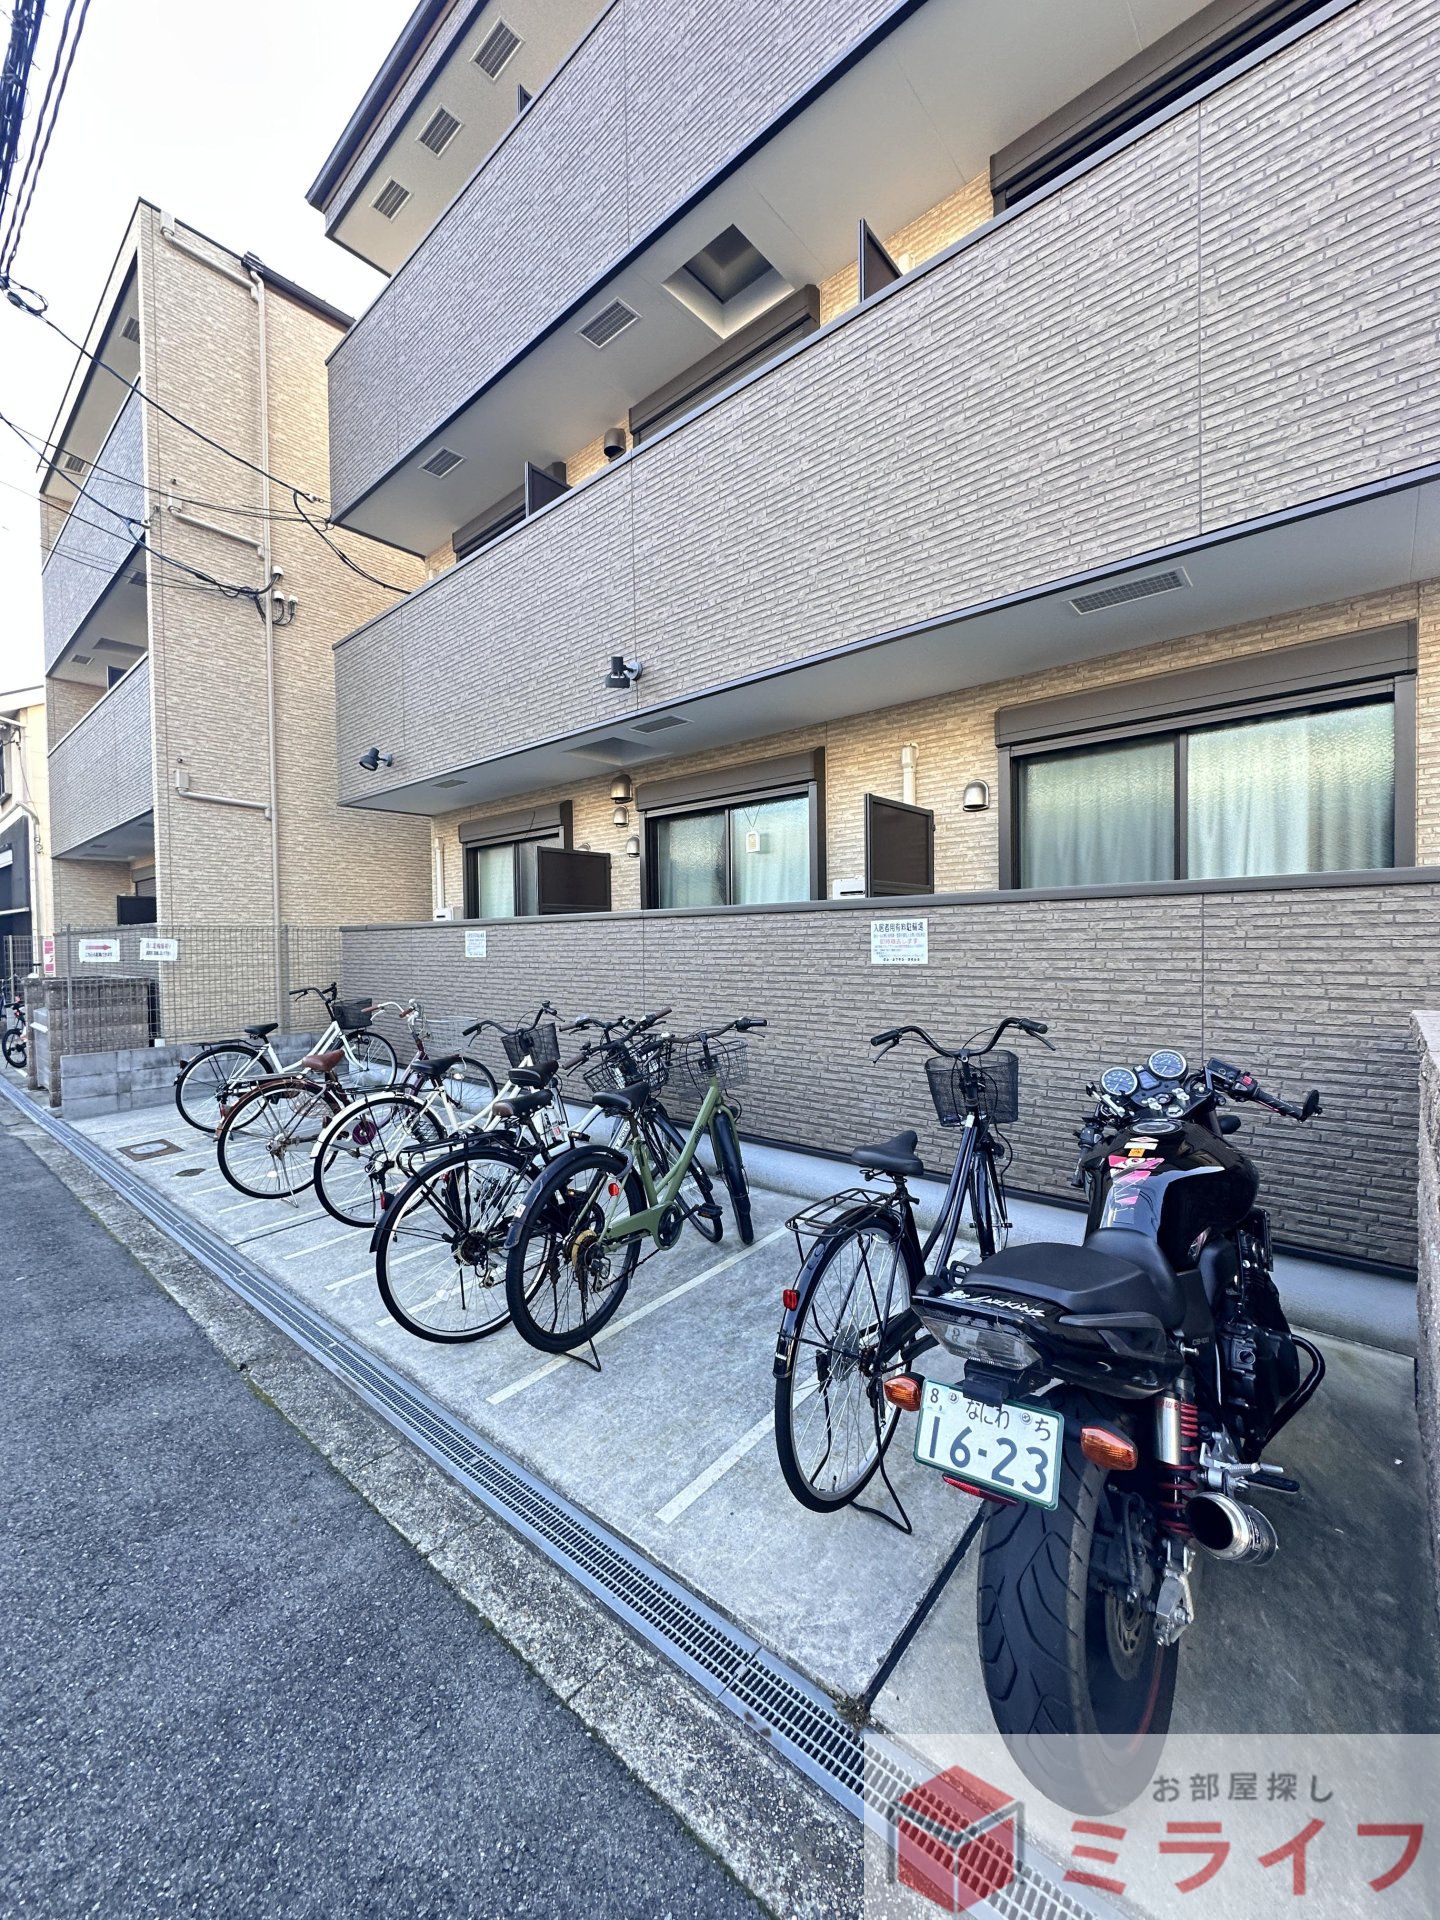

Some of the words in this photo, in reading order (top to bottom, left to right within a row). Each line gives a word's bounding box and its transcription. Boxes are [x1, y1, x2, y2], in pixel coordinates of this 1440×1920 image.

[930, 1387, 939, 1404] 8
[966, 1400, 1010, 1430] なにわ
[1034, 1417, 1051, 1442] ち
[929, 1416, 1049, 1495] 16-23
